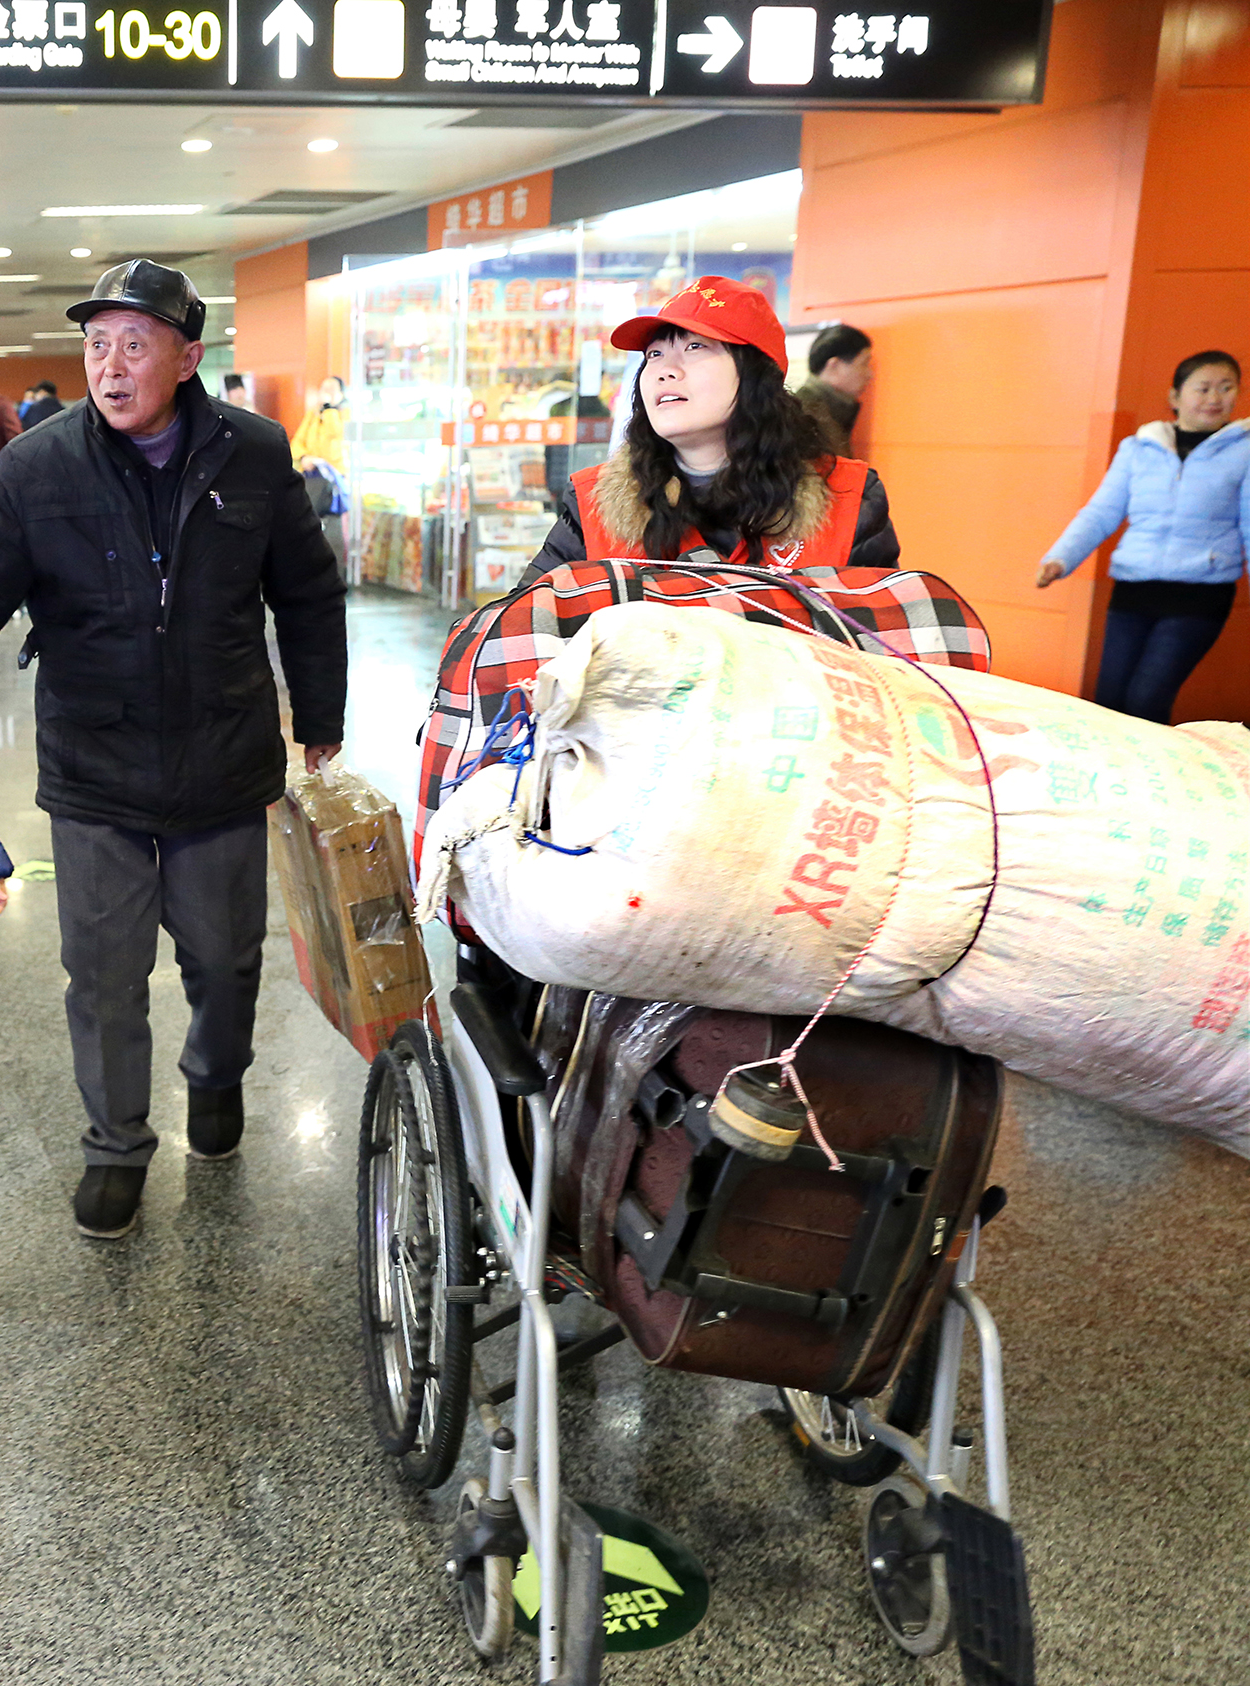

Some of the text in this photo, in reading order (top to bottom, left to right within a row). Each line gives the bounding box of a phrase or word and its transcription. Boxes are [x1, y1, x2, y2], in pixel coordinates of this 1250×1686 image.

[94, 9, 222, 60] 10-30
[831, 12, 930, 56] 洗手间
[829, 53, 885, 79] Toilet
[602, 1587, 669, 1620] 出口
[602, 1611, 659, 1635] XIT
